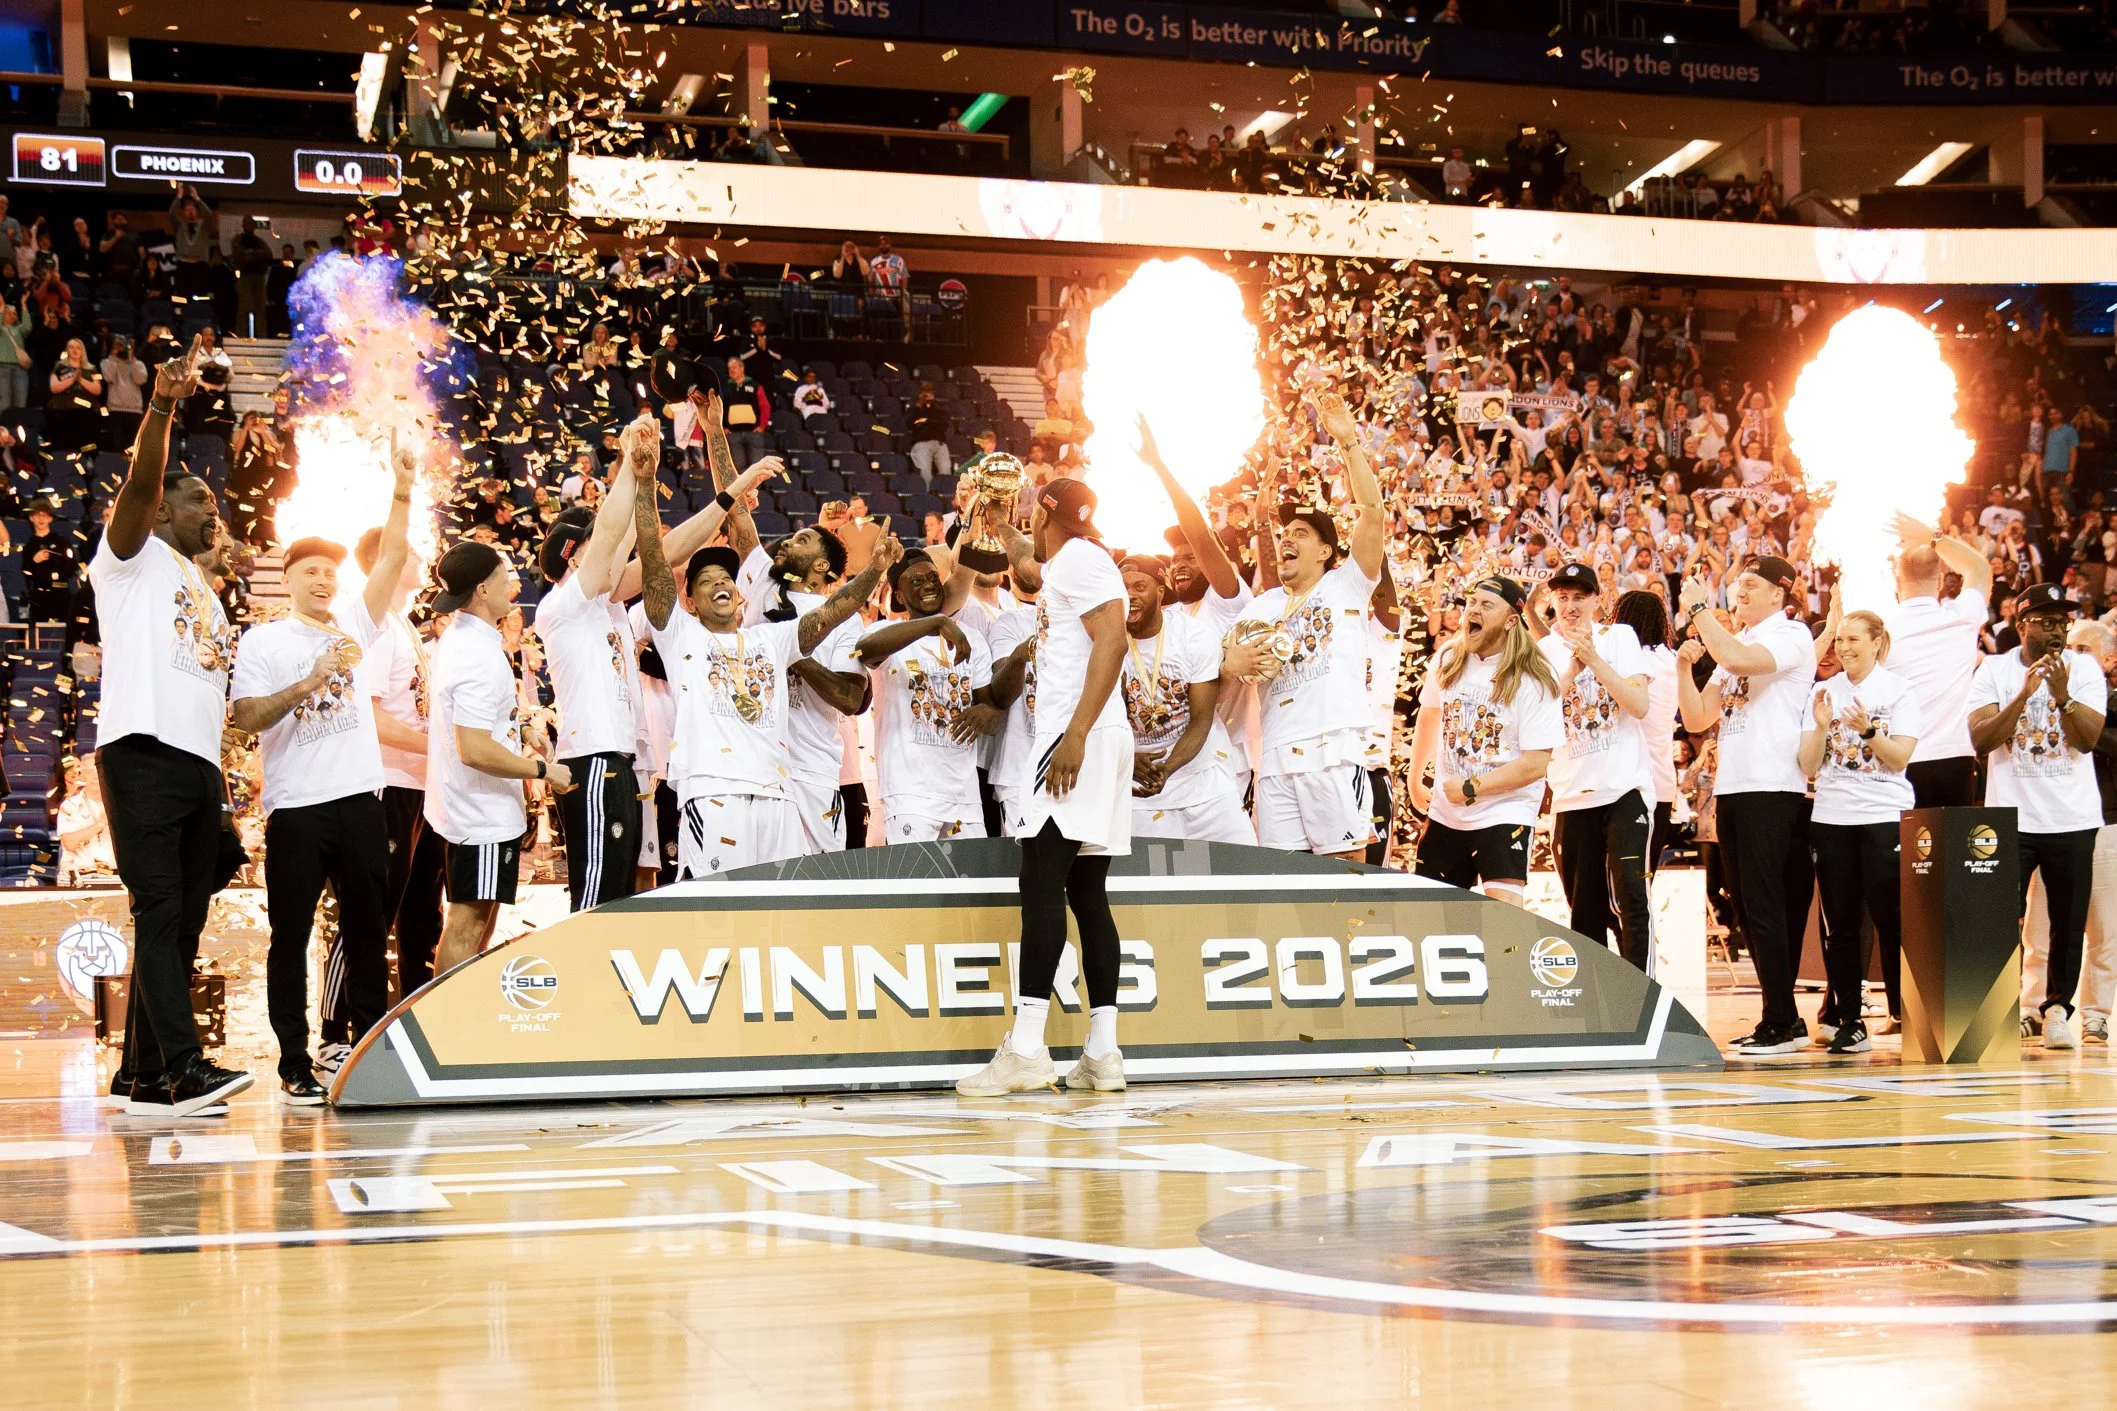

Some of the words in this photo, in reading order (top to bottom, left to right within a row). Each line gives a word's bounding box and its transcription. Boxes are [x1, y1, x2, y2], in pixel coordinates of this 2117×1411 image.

[833, 0, 890, 18] bars
[1070, 9, 1118, 34] The
[1161, 15, 1181, 39] is
[1191, 18, 1268, 45] better
[1338, 29, 1425, 64] Priority
[1580, 46, 1630, 77] Skip
[1634, 54, 1671, 76] the
[1681, 62, 1761, 83] queues
[1899, 65, 1944, 87] The
[1986, 65, 2004, 87] is
[2014, 65, 2088, 87] better
[40, 147, 78, 172] 81
[140, 155, 225, 174] PHOENIX
[315, 160, 363, 185] 0.0
[1508, 395, 1541, 406] NDON
[1974, 838, 1998, 846] SLB
[1964, 860, 2000, 868] PLAY-OFF
[1543, 956, 1577, 966] SLB
[1201, 935, 1489, 1011] 2026
[516, 977, 557, 988] SLB
[1530, 988, 1583, 998] PLAY-OFF
[1541, 998, 1575, 1007] FINAL
[498, 1012, 562, 1023] PLAY-OFF
[511, 1023, 551, 1032] FINAL
